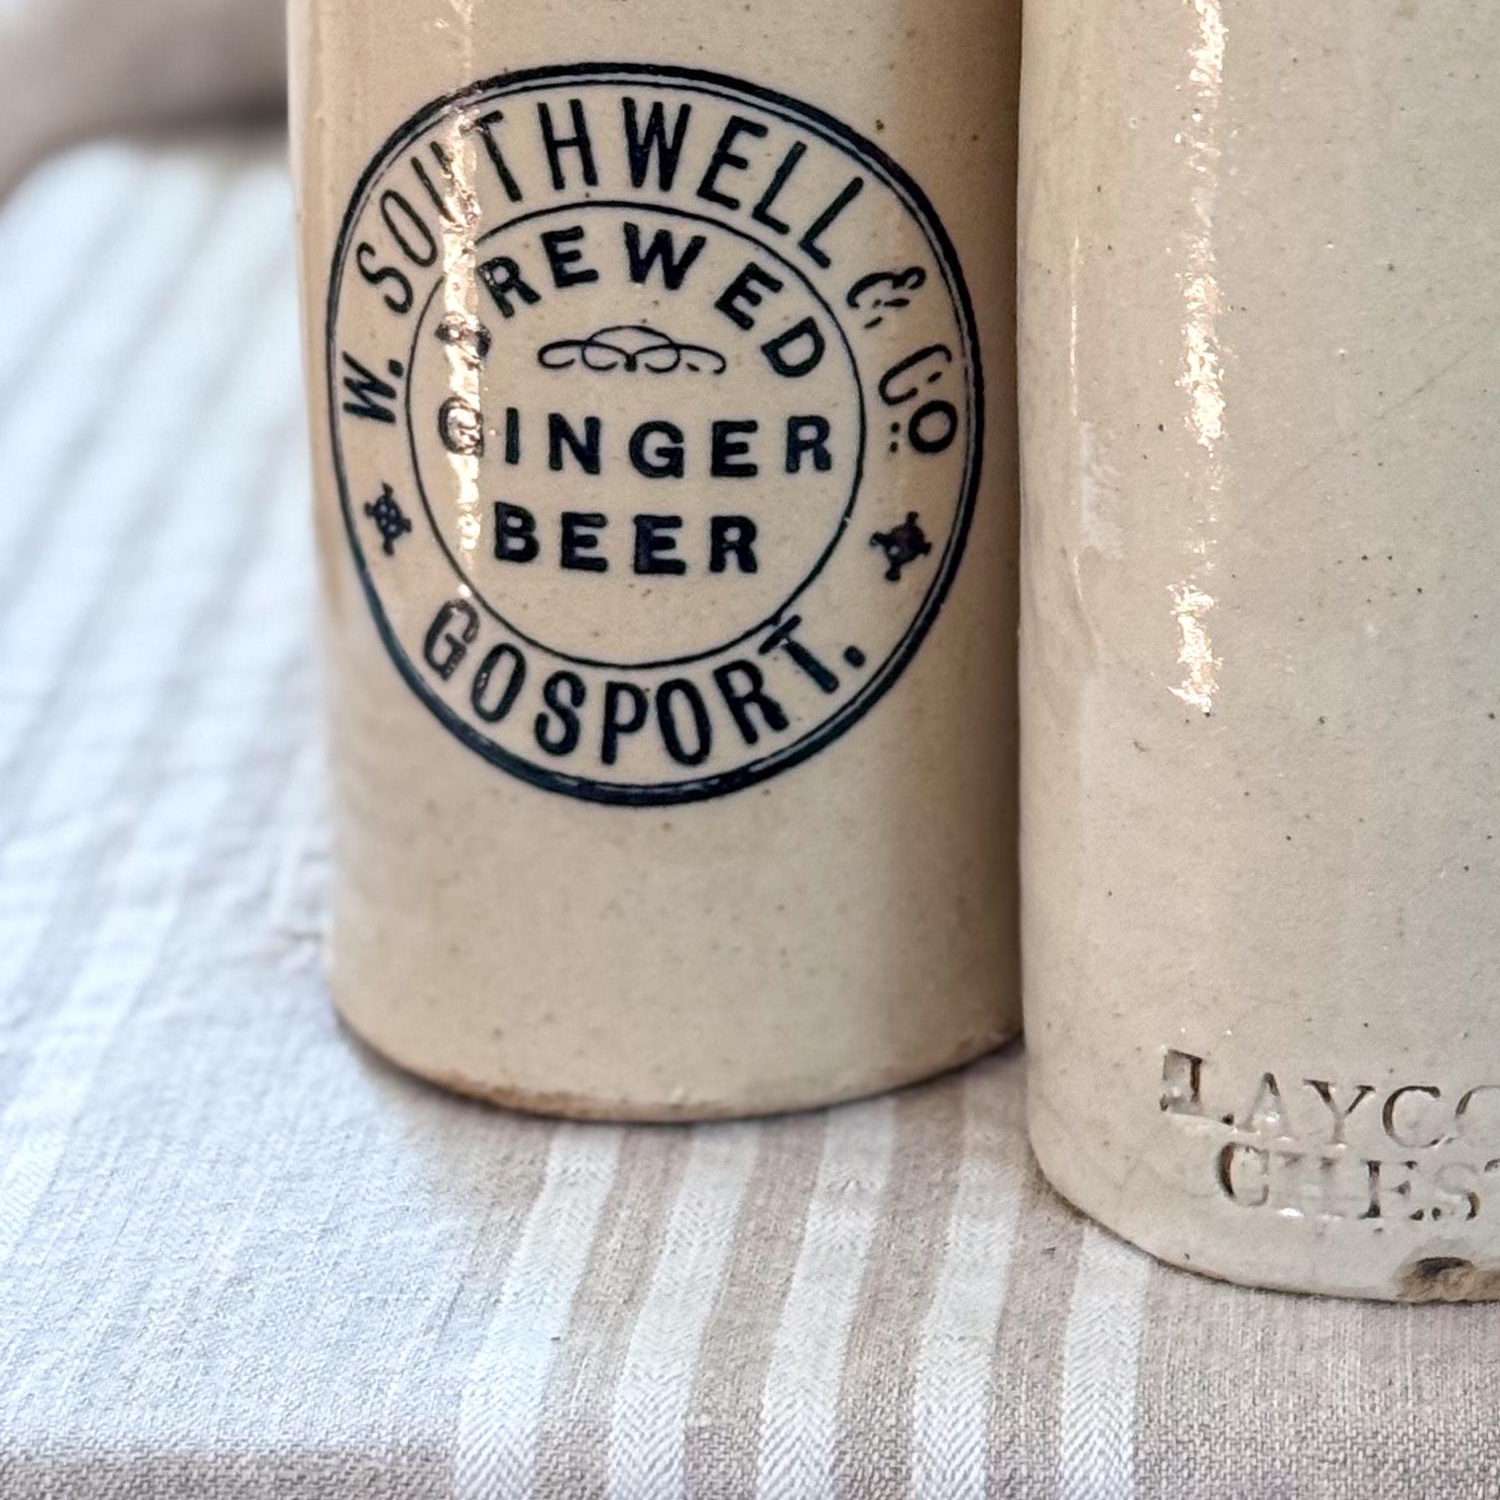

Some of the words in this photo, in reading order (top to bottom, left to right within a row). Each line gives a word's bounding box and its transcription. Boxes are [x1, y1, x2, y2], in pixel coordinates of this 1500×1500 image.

[342, 350, 404, 425] W.
[437, 398, 833, 480] GINGER
[494, 501, 758, 576] BEER
